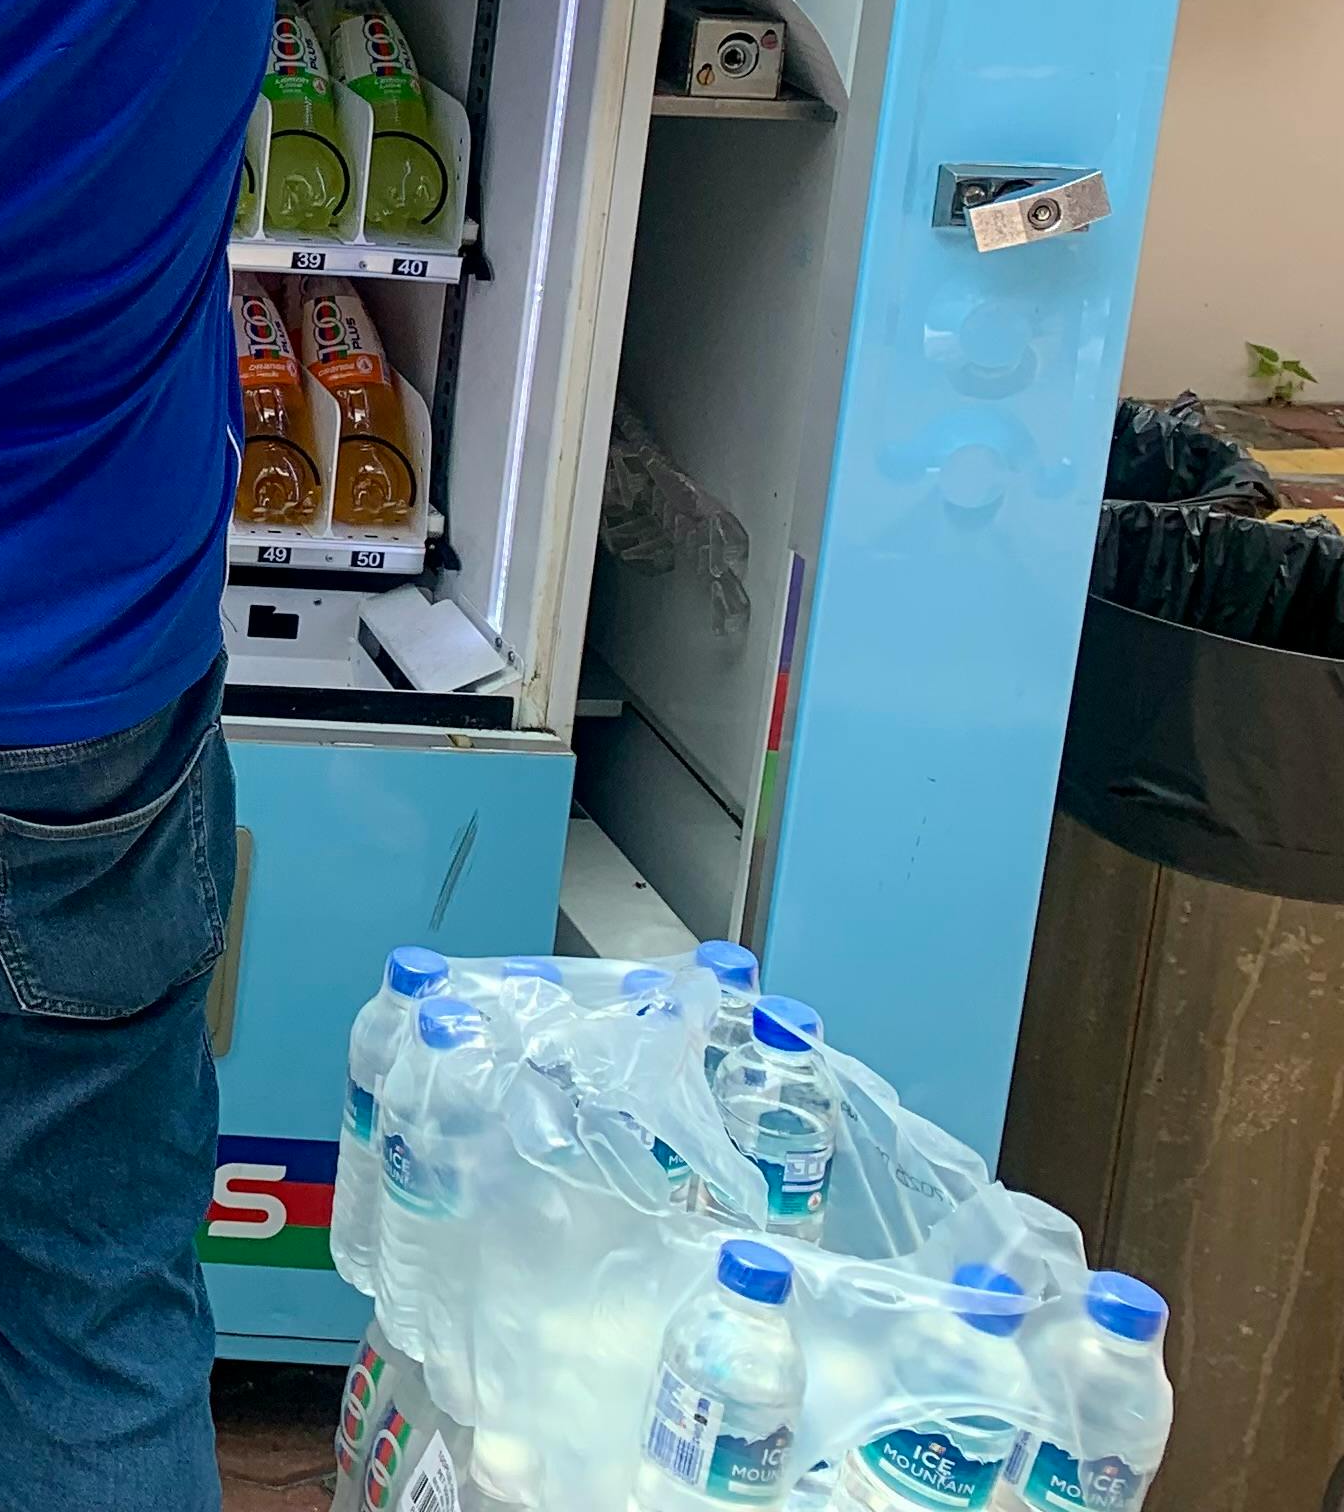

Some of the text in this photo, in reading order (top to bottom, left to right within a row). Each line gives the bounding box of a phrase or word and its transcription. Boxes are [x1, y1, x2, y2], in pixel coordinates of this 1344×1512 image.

[363, 18, 402, 73] 100
[296, 253, 322, 268] 39
[397, 260, 423, 275] 40
[312, 300, 349, 359] 100
[343, 316, 363, 350] PLUS
[262, 547, 288, 562] 49
[356, 552, 381, 567] 50
[884, 1443, 975, 1495] MOUNTAIN
[913, 1445, 955, 1474] ICE
